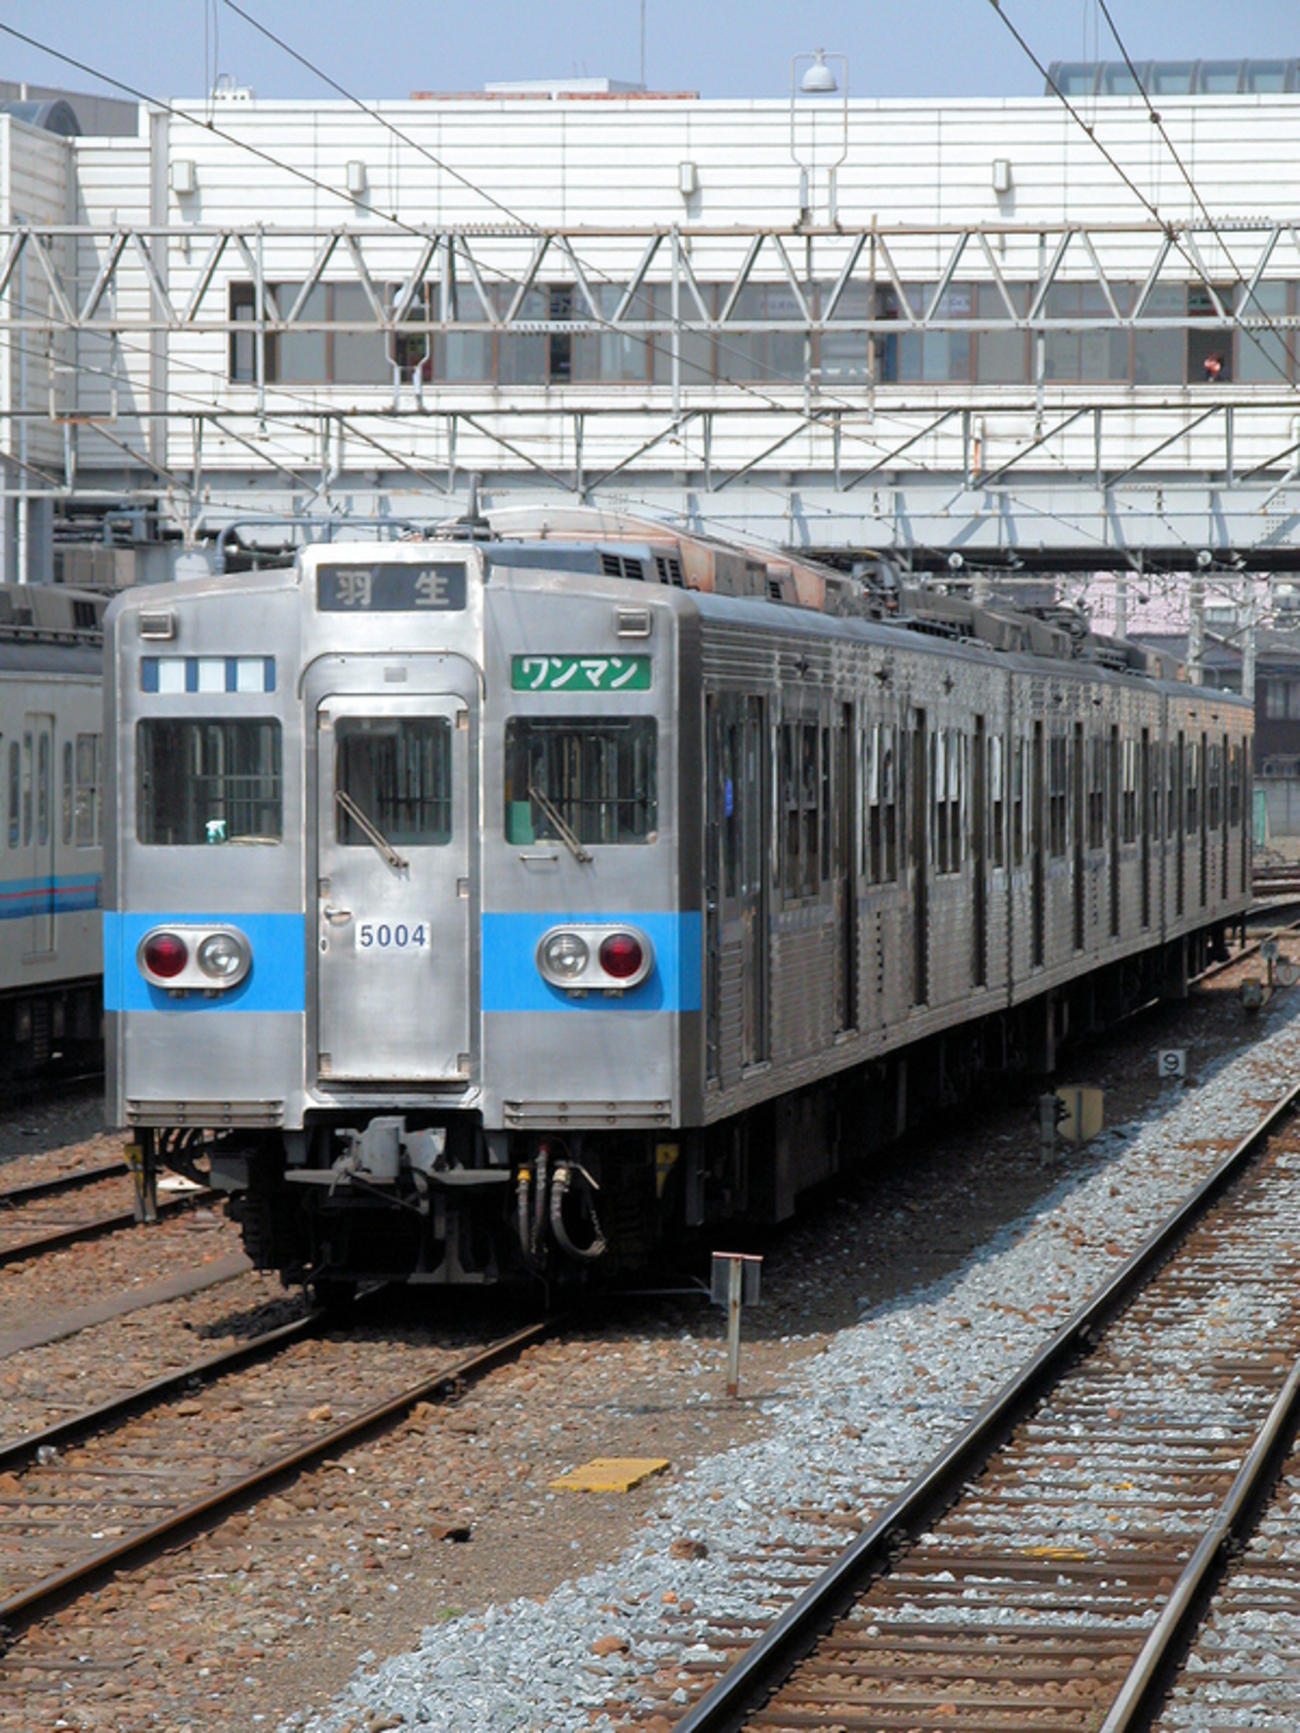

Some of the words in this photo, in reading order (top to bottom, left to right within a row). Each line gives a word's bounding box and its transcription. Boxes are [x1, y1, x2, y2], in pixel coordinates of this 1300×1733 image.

[336, 570, 449, 605] 羽生
[522, 657, 637, 688] ワンマン
[360, 924, 425, 947] 5004
[1163, 1053, 1179, 1071] 9
